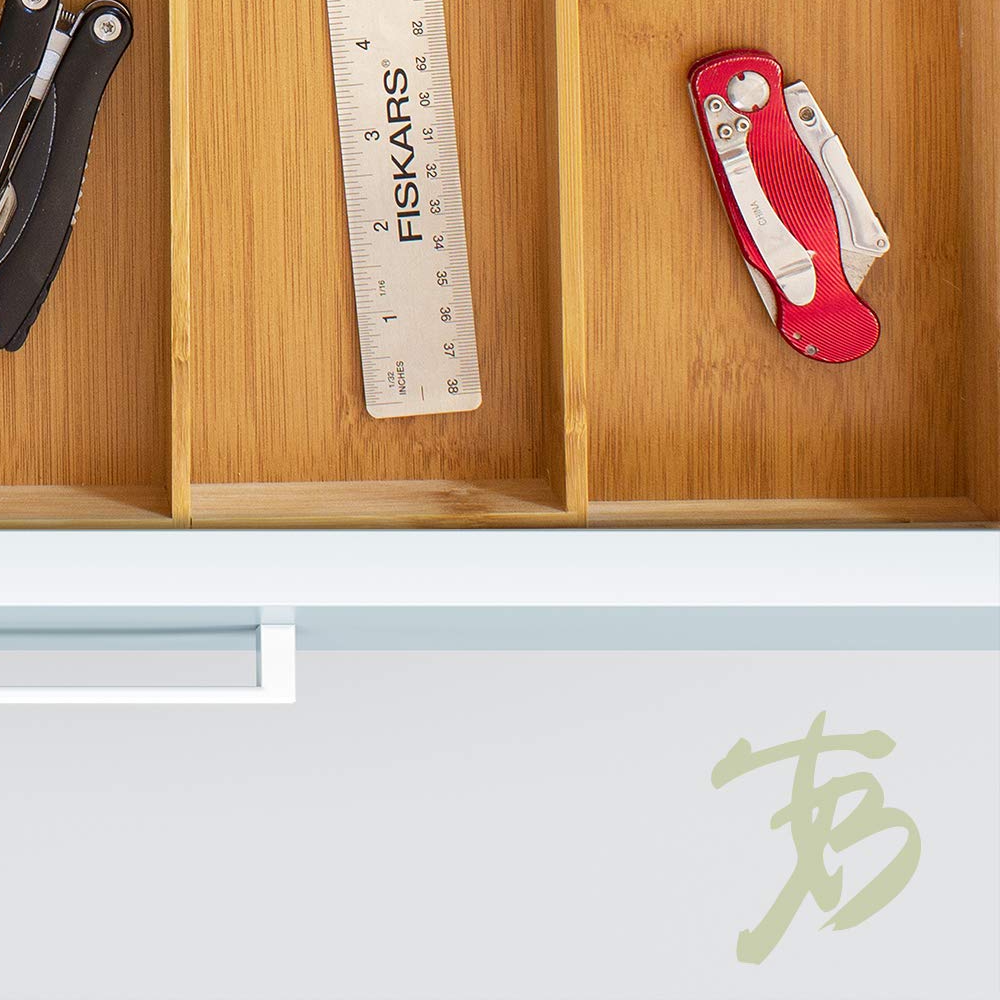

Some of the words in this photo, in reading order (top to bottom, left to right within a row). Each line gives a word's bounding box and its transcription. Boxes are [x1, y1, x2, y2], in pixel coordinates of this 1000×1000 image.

[412, 21, 423, 35] 28
[356, 40, 371, 50] 4
[416, 56, 427, 71] 29
[419, 92, 430, 107] 30
[364, 130, 380, 141] 3
[423, 127, 434, 141] 31
[426, 163, 437, 178] 32
[429, 199, 441, 214] 33
[750, 199, 766, 226] CHINA
[373, 221, 389, 232] 2
[433, 235, 444, 250] 34
[436, 271, 448, 285] 35
[378, 280, 386, 296] 1/16
[382, 315, 397, 323] 1
[440, 307, 451, 322] 36
[443, 343, 455, 357] 37
[395, 360, 407, 395] INCHES
[447, 379, 459, 393] 38
